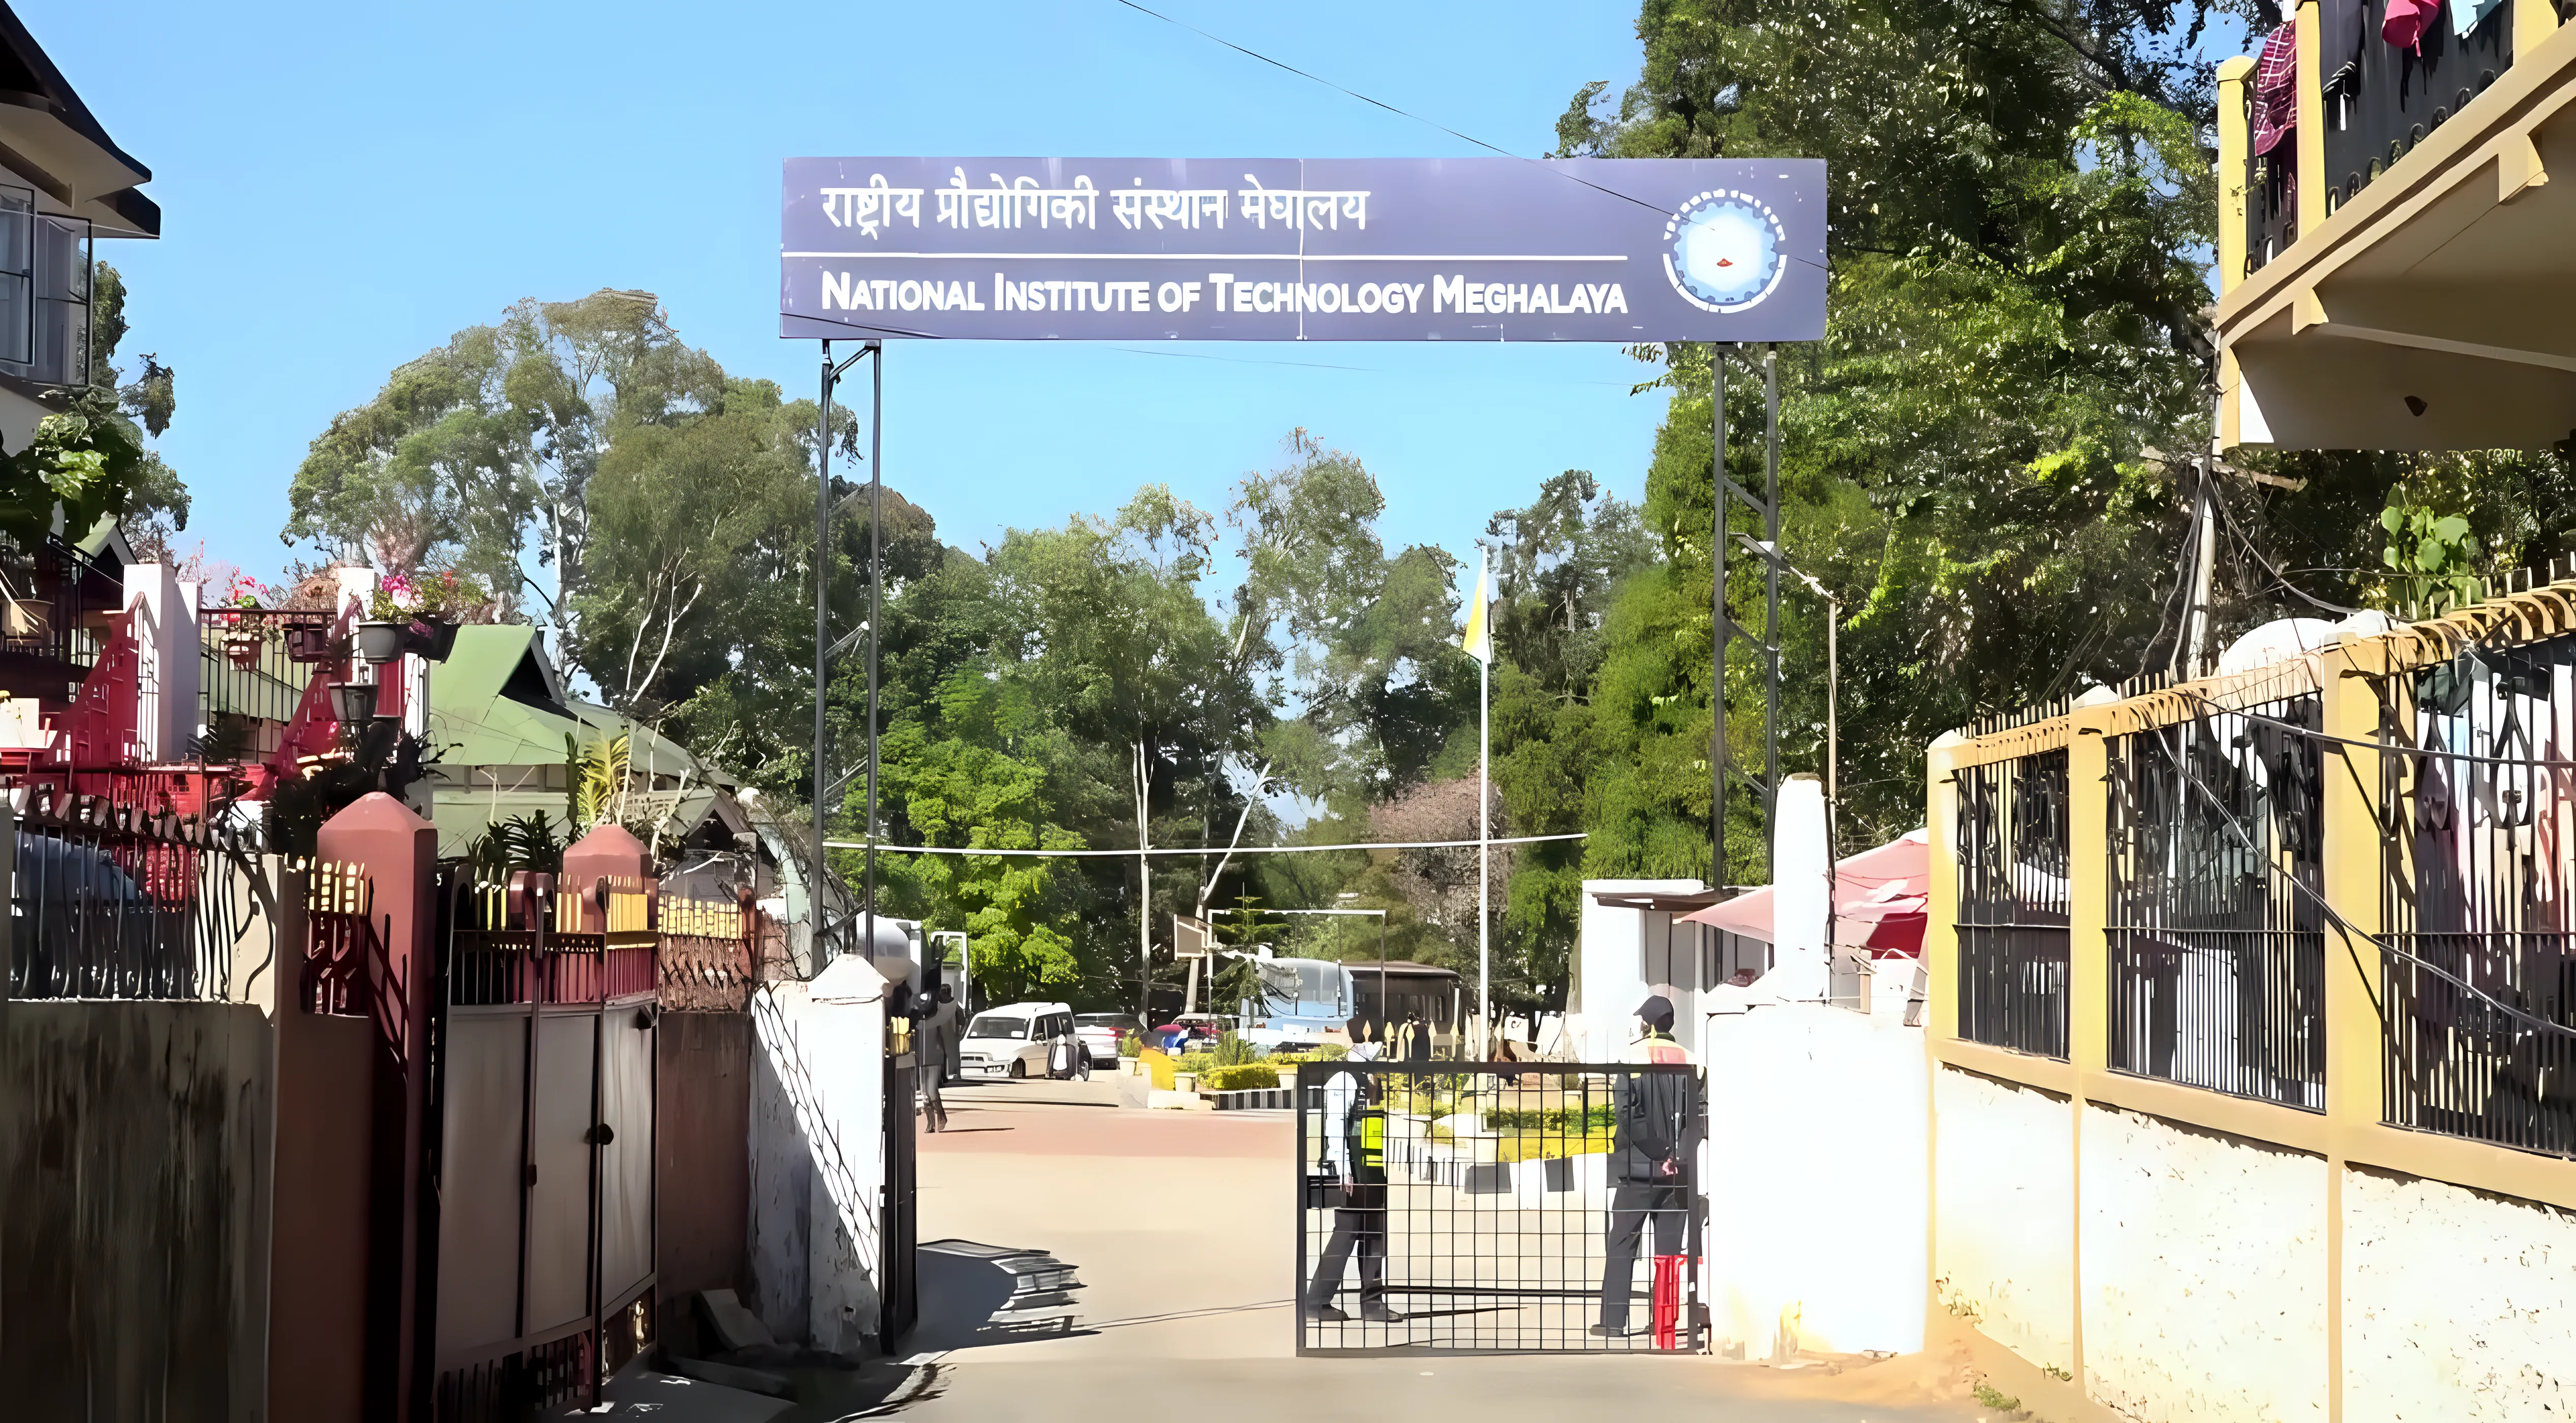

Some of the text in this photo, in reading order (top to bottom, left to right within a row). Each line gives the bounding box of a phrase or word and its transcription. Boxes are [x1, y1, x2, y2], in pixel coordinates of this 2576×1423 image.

[820, 166, 1371, 240] राष्ट्रीय प्रौद्योगिकी संस्थान मेघालय
[822, 270, 985, 311] NATIONAL
[995, 272, 1150, 312] INSTITUTE
[1157, 282, 1201, 313] OF
[1209, 273, 1425, 314] TECHNOLOGY
[1433, 274, 1628, 314] MEGHALAYA
